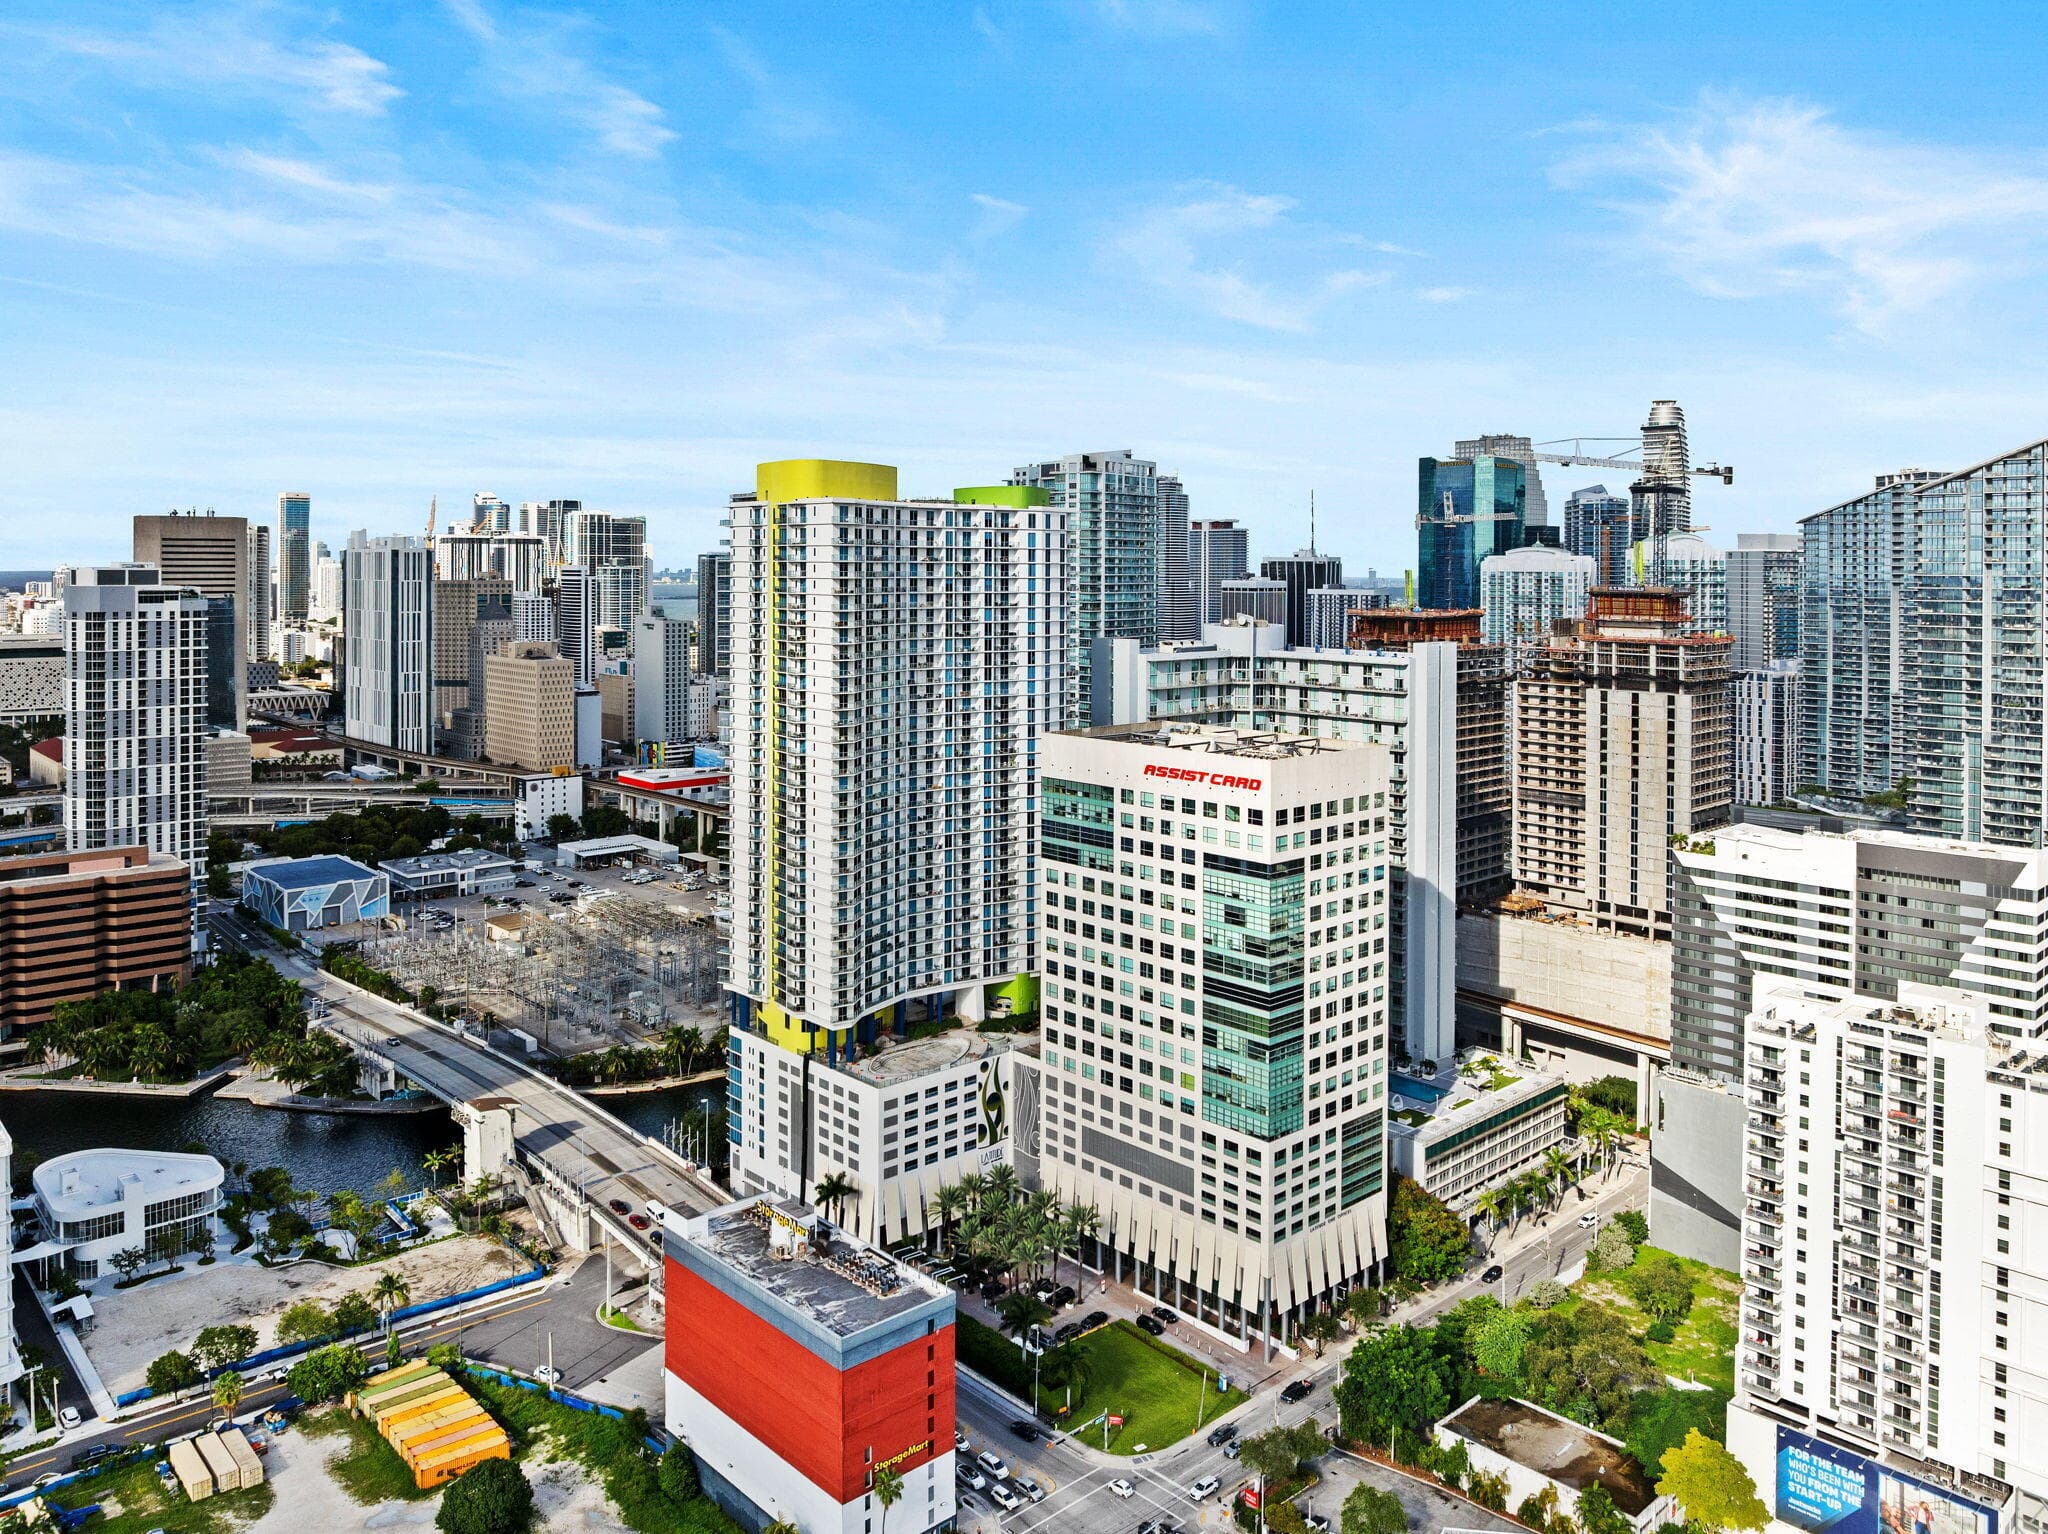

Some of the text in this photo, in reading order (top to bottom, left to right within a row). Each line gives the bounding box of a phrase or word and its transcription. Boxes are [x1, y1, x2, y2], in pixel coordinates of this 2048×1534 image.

[1143, 764, 1262, 791] ASSIST CARD
[874, 1440, 929, 1473] StorageMart
[1788, 1445, 1865, 1485] FOR THE TEAM
[1788, 1457, 1865, 1499] WHO'S BEEN WITH
[1788, 1469, 1862, 1508] YOU FROM THE
